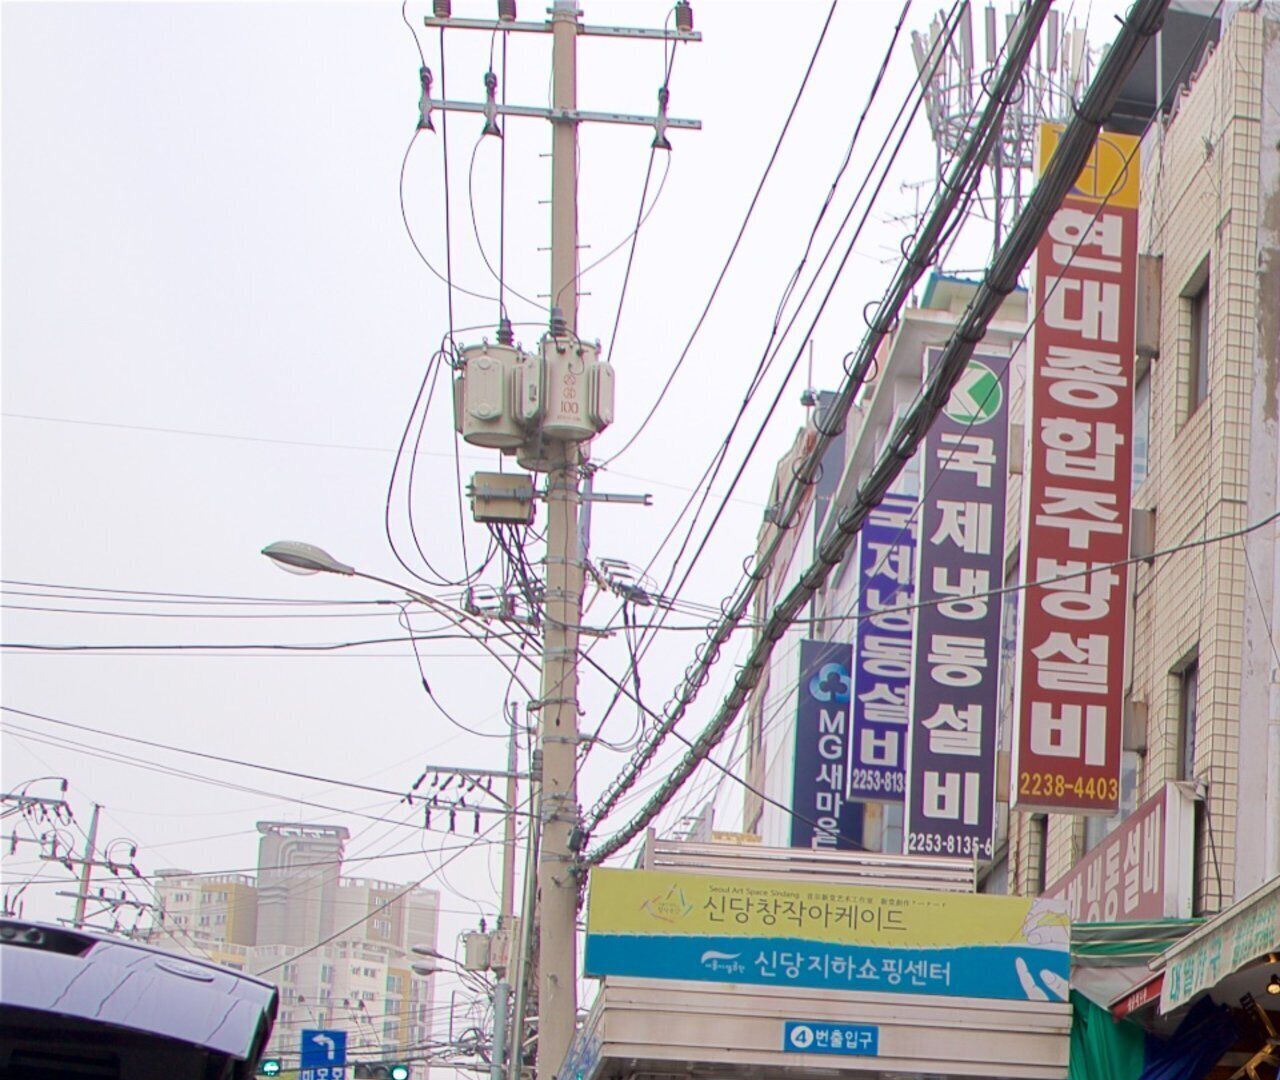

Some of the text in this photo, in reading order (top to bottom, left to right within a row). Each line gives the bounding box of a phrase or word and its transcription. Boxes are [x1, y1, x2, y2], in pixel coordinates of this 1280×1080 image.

[1029, 206, 1127, 766] 현대종합주방설비
[921, 433, 997, 826] 국제냉동설비
[1020, 773, 1118, 801] 2238-4403
[908, 831, 992, 857] 2253-8135-6
[703, 894, 907, 932] 신당창작아케이드
